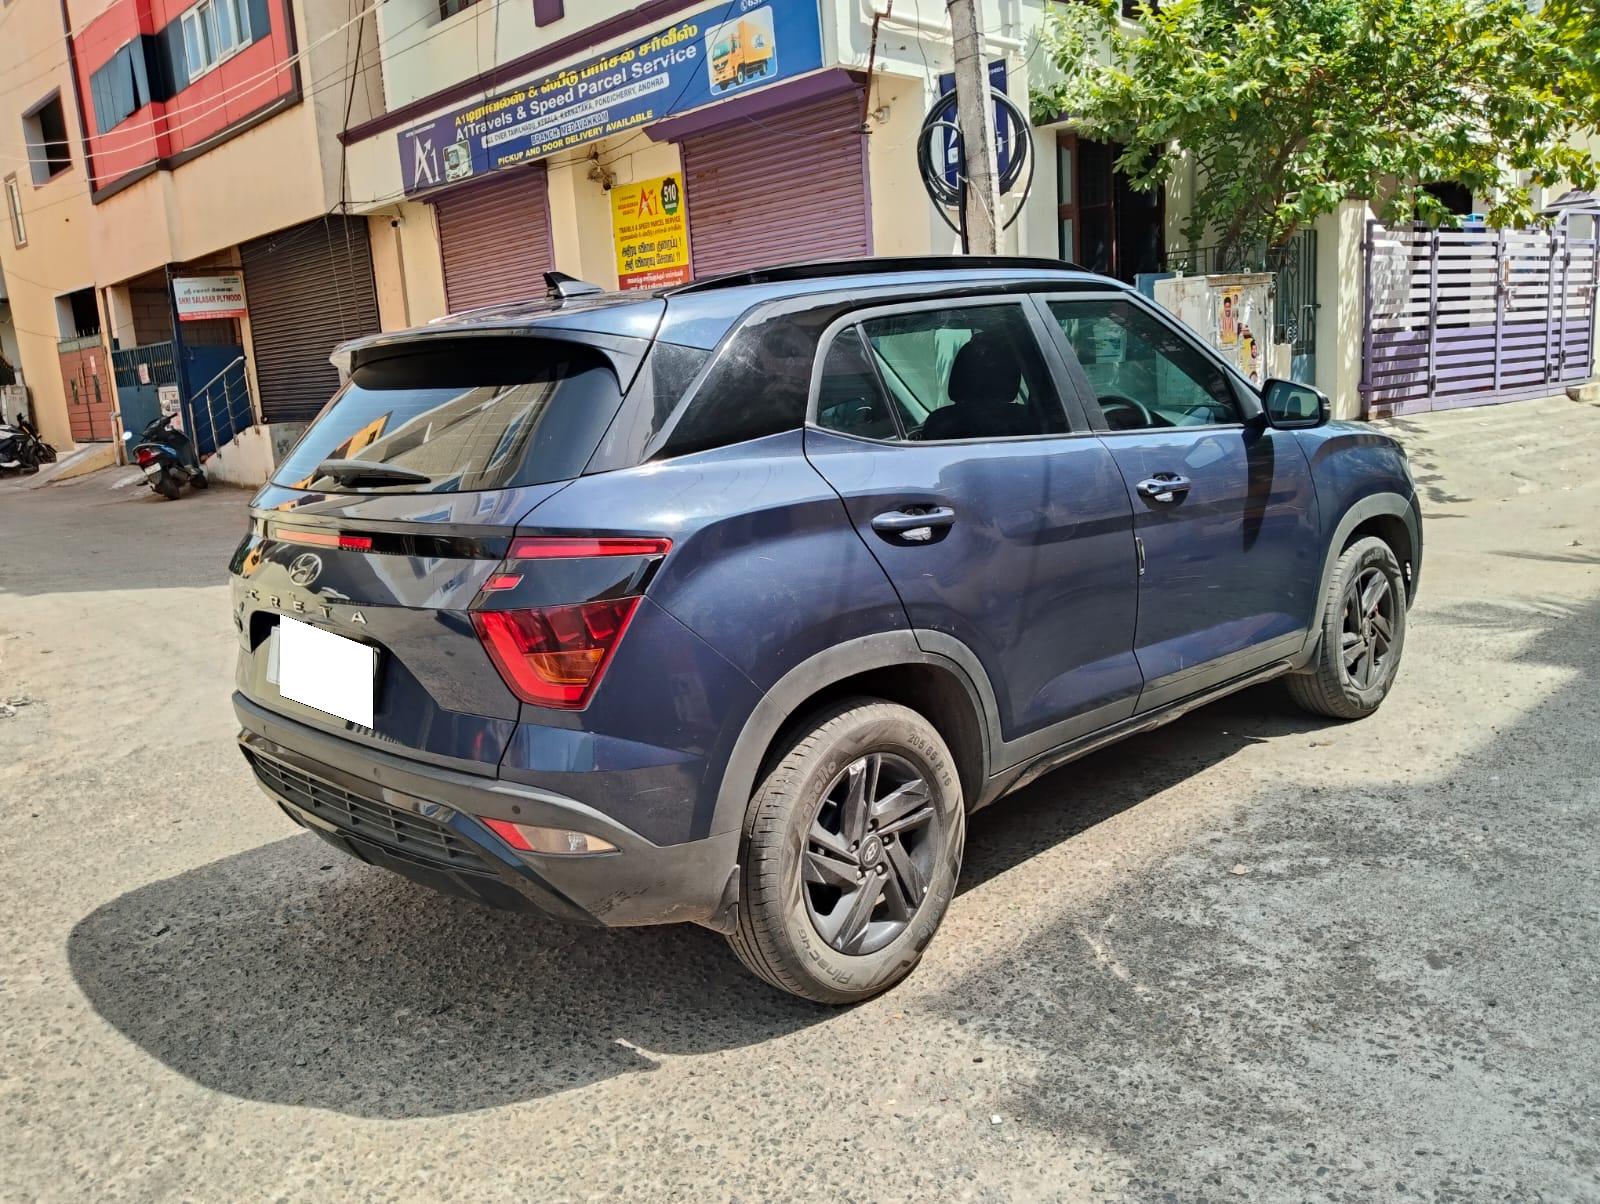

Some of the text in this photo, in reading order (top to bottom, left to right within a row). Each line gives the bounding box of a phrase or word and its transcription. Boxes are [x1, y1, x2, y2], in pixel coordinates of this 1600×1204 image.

[516, 105, 527, 120] &
[530, 89, 574, 115] Speed
[578, 68, 627, 98] Parcel
[631, 45, 697, 78] Service
[528, 85, 539, 98] &
[638, 76, 665, 92] ANDHRA
[497, 109, 654, 166] PICKUP AND DOOR DELIVERY AVAILABLE
[664, 185, 677, 203] 510
